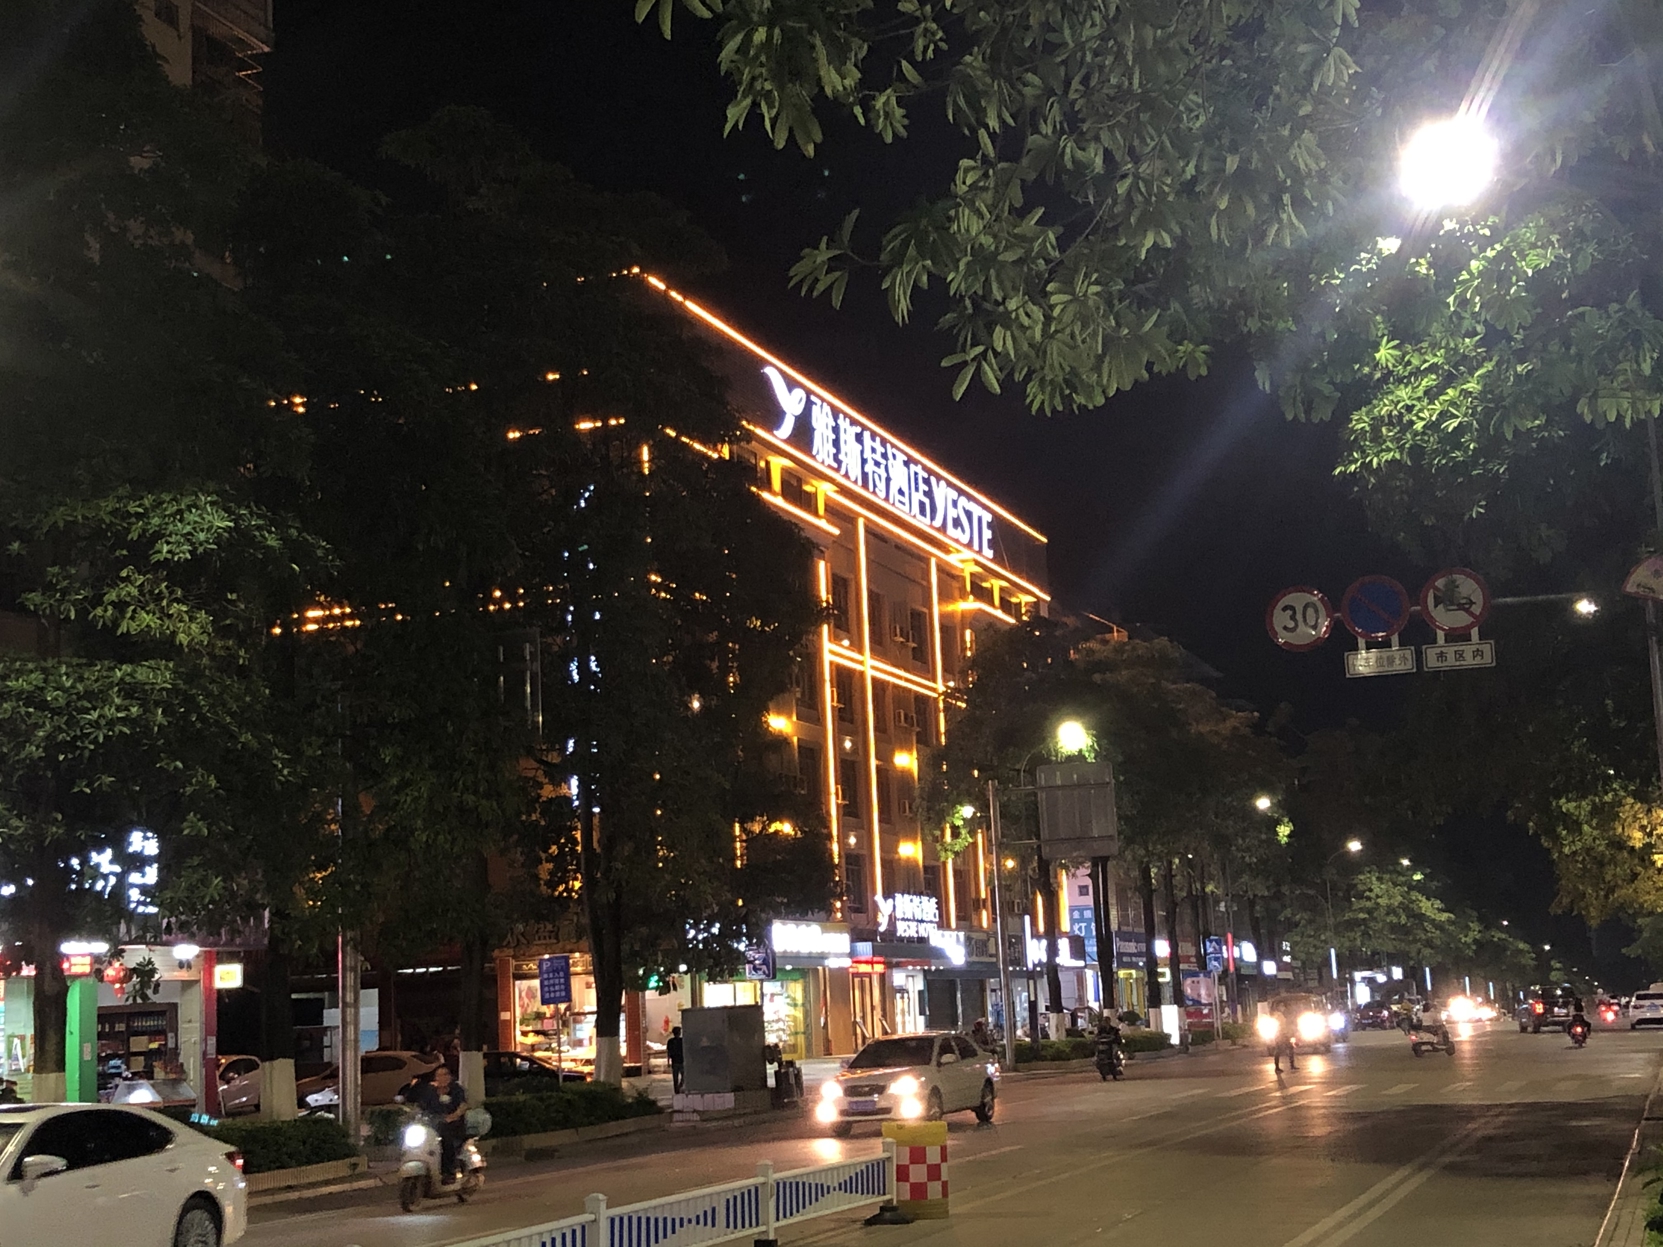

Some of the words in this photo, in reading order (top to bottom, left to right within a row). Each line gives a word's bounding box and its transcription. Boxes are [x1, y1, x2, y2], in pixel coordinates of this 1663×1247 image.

[810, 395, 930, 523] 雅斯特酒店
[931, 476, 993, 558] YESTE
[1281, 602, 1320, 635] 30
[1435, 649, 1485, 664] 市区内
